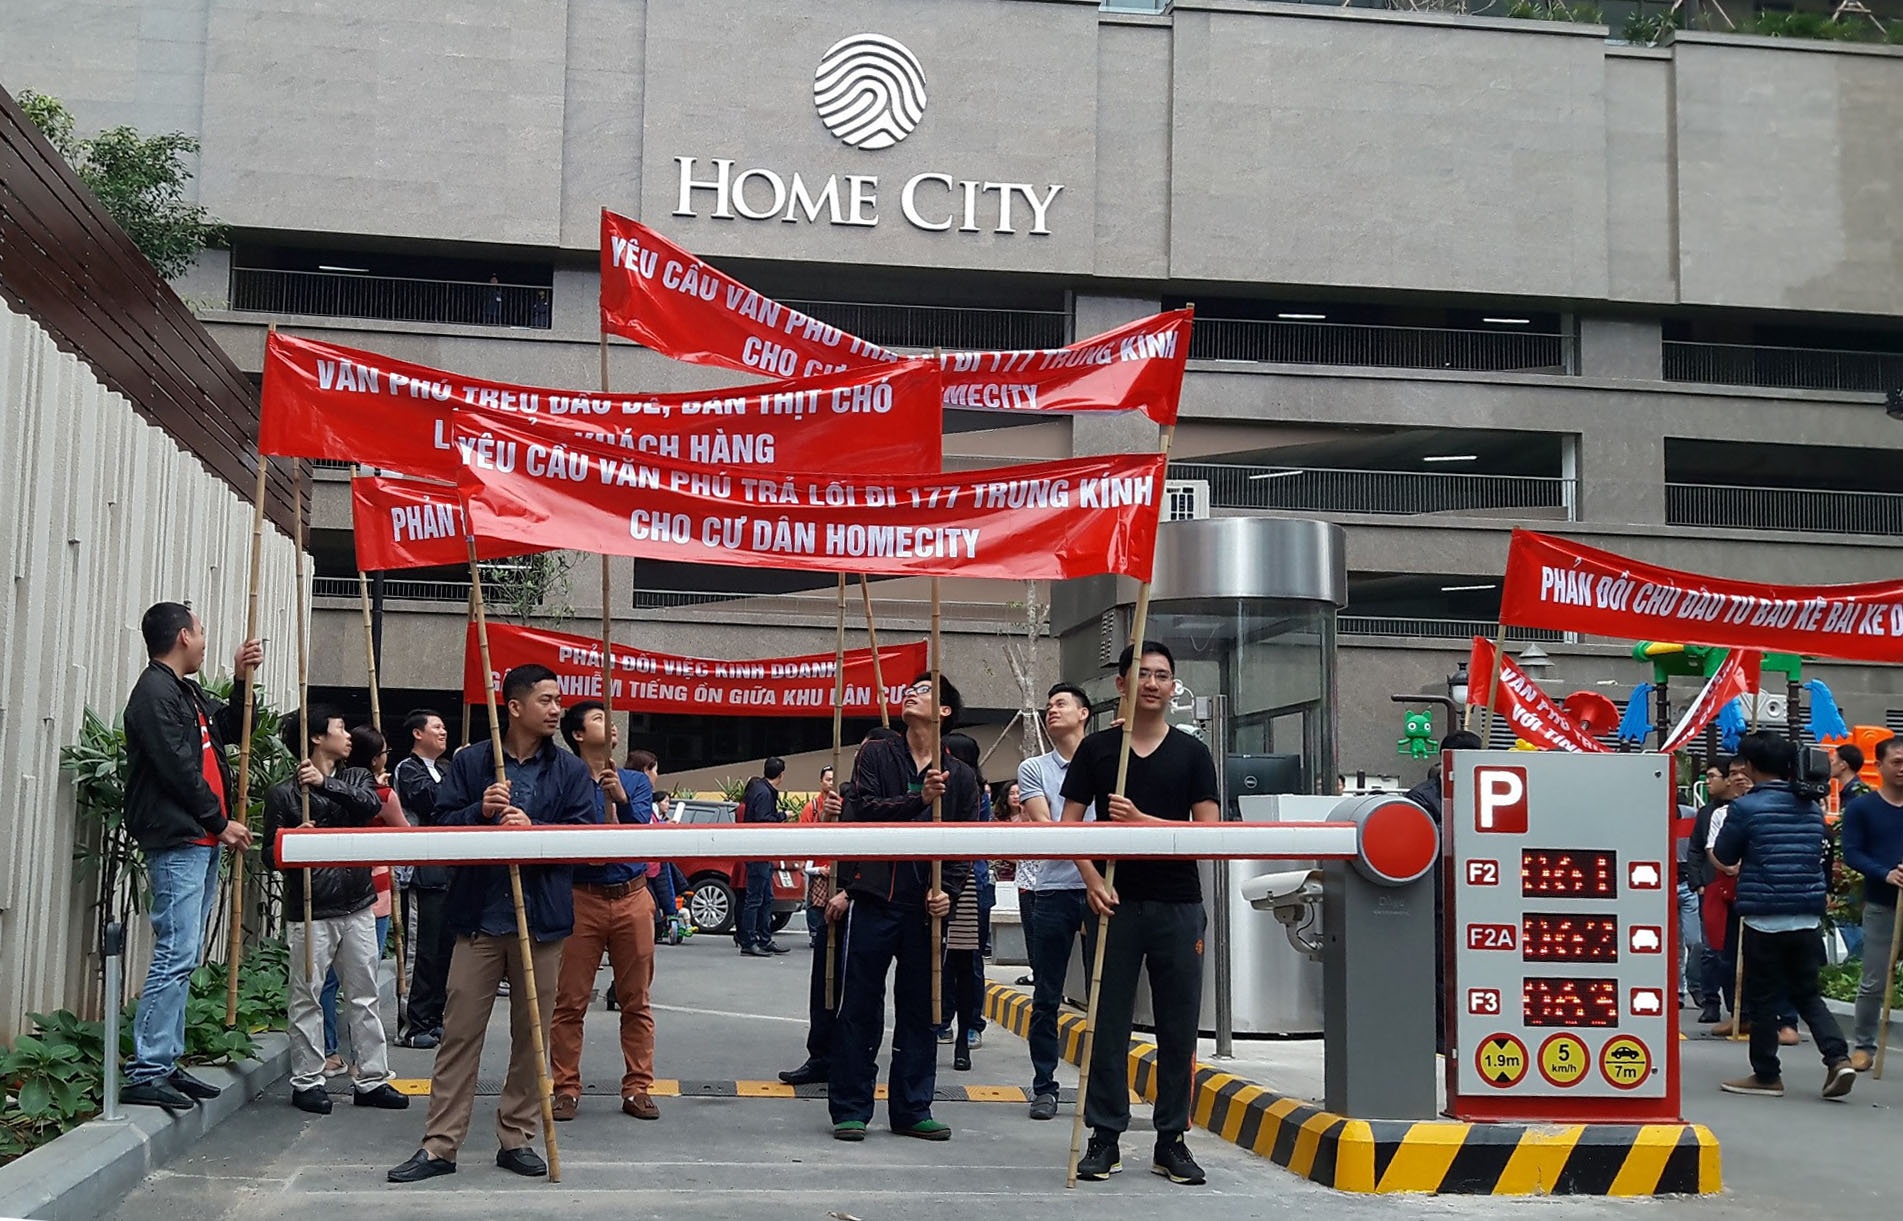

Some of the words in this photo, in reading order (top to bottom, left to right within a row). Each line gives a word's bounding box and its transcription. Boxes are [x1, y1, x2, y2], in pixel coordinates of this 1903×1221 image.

[673, 156, 879, 228] HOME
[902, 173, 1064, 235] CITY
[611, 235, 658, 280] YÊU
[663, 259, 719, 301] CẦU
[989, 349, 1036, 373] 177
[1038, 341, 1116, 371] TRUNG
[1120, 330, 1179, 362] KÍNH
[316, 357, 380, 394] VĂN
[831, 376, 893, 414] CHÓ
[742, 335, 798, 378] CHO
[940, 383, 1038, 409] MECITY
[689, 427, 775, 465] HÀNG
[457, 432, 517, 474] YÊU
[525, 442, 590, 482] CẦU
[599, 456, 660, 490] VĂN
[669, 470, 732, 498] PHÚ
[741, 476, 800, 505] TRẢ
[808, 480, 856, 507] LỐI
[865, 485, 897, 508] ĐI
[906, 485, 961, 509] 177
[970, 479, 1070, 510] TRUNG
[1079, 471, 1155, 509] KÍNH
[390, 494, 457, 543] PHẢN
[628, 508, 692, 544] CHO
[701, 515, 748, 550] CƯ
[752, 514, 817, 555] DÂN
[825, 522, 981, 559] HOMECITY
[1540, 557, 1593, 607] PHẢN
[1596, 569, 1636, 612] ĐỐI
[1857, 603, 1888, 636] XE
[714, 662, 765, 679] KINH
[770, 661, 837, 679] DOANH
[628, 678, 688, 702] TIẾNG
[693, 681, 724, 704] ỒN
[728, 685, 777, 706] GIỮA
[782, 687, 823, 707] KHU
[1480, 770, 1523, 828] P
[1469, 863, 1496, 882] F2
[1470, 928, 1514, 947] F2A
[1471, 992, 1498, 1011] F3
[1484, 1053, 1520, 1067] 1.9m
[1551, 1064, 1577, 1074] km/h
[1558, 1044, 1570, 1062] 5
[1614, 1065, 1637, 1078] 7m
